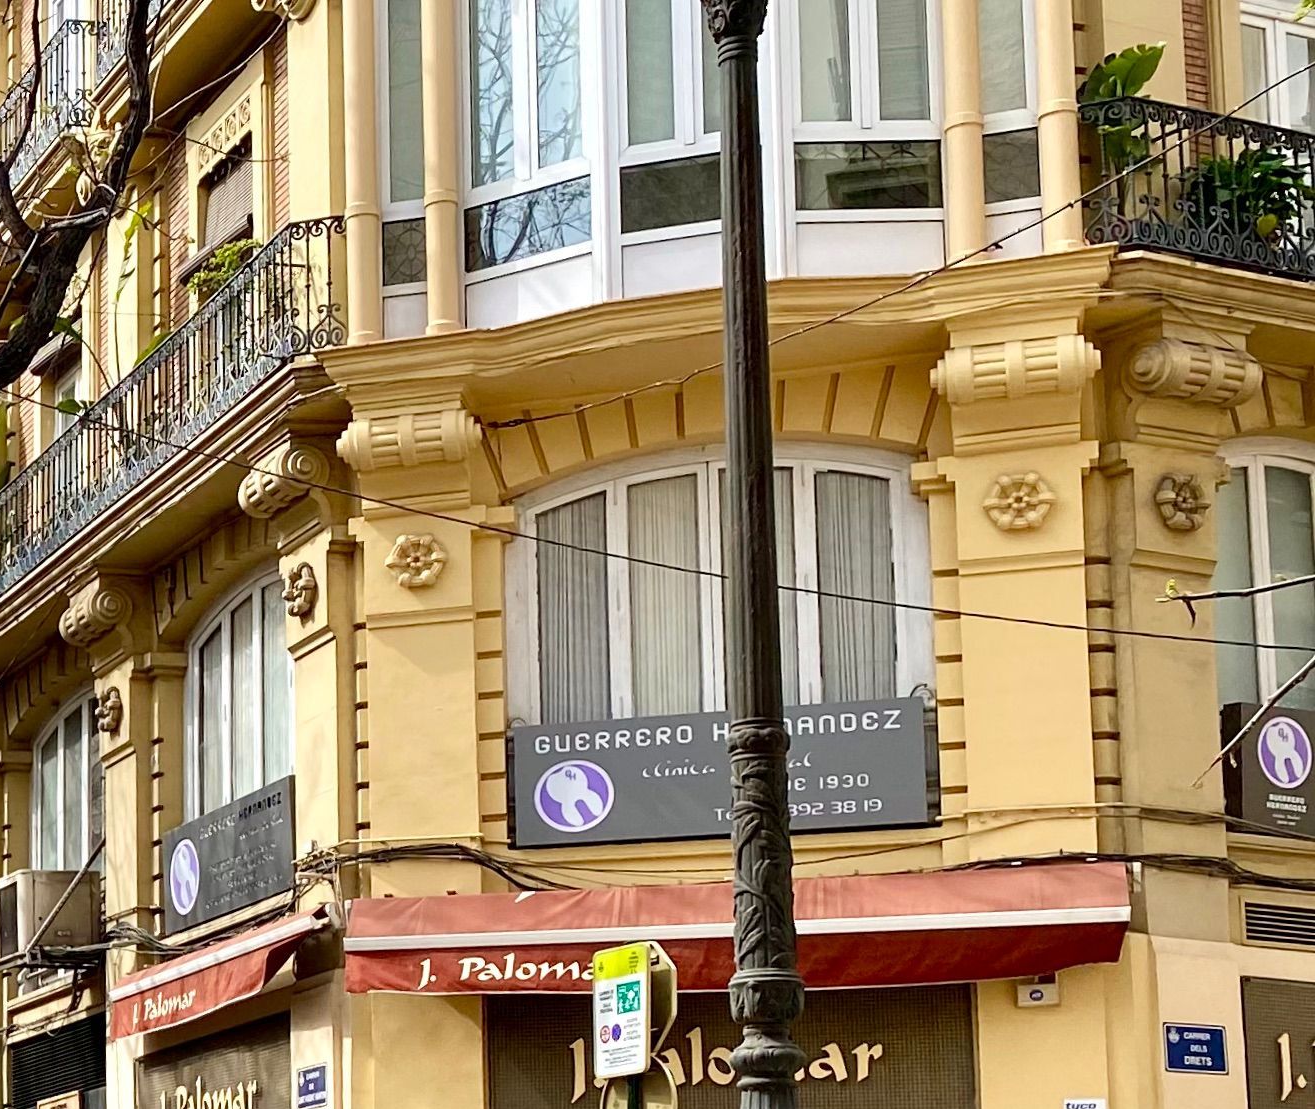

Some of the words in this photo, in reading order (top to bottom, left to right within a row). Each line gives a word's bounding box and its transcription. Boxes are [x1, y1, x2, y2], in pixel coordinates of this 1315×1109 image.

[534, 725, 694, 755] GUERRERO
[712, 708, 902, 742] HNANDEZ
[819, 773, 870, 791] 1930
[830, 800, 858, 815] 38
[863, 798, 883, 813] 19
[417, 958, 437, 991] J.
[142, 988, 197, 1022] Palomar
[1183, 1032, 1211, 1040] CARRER
